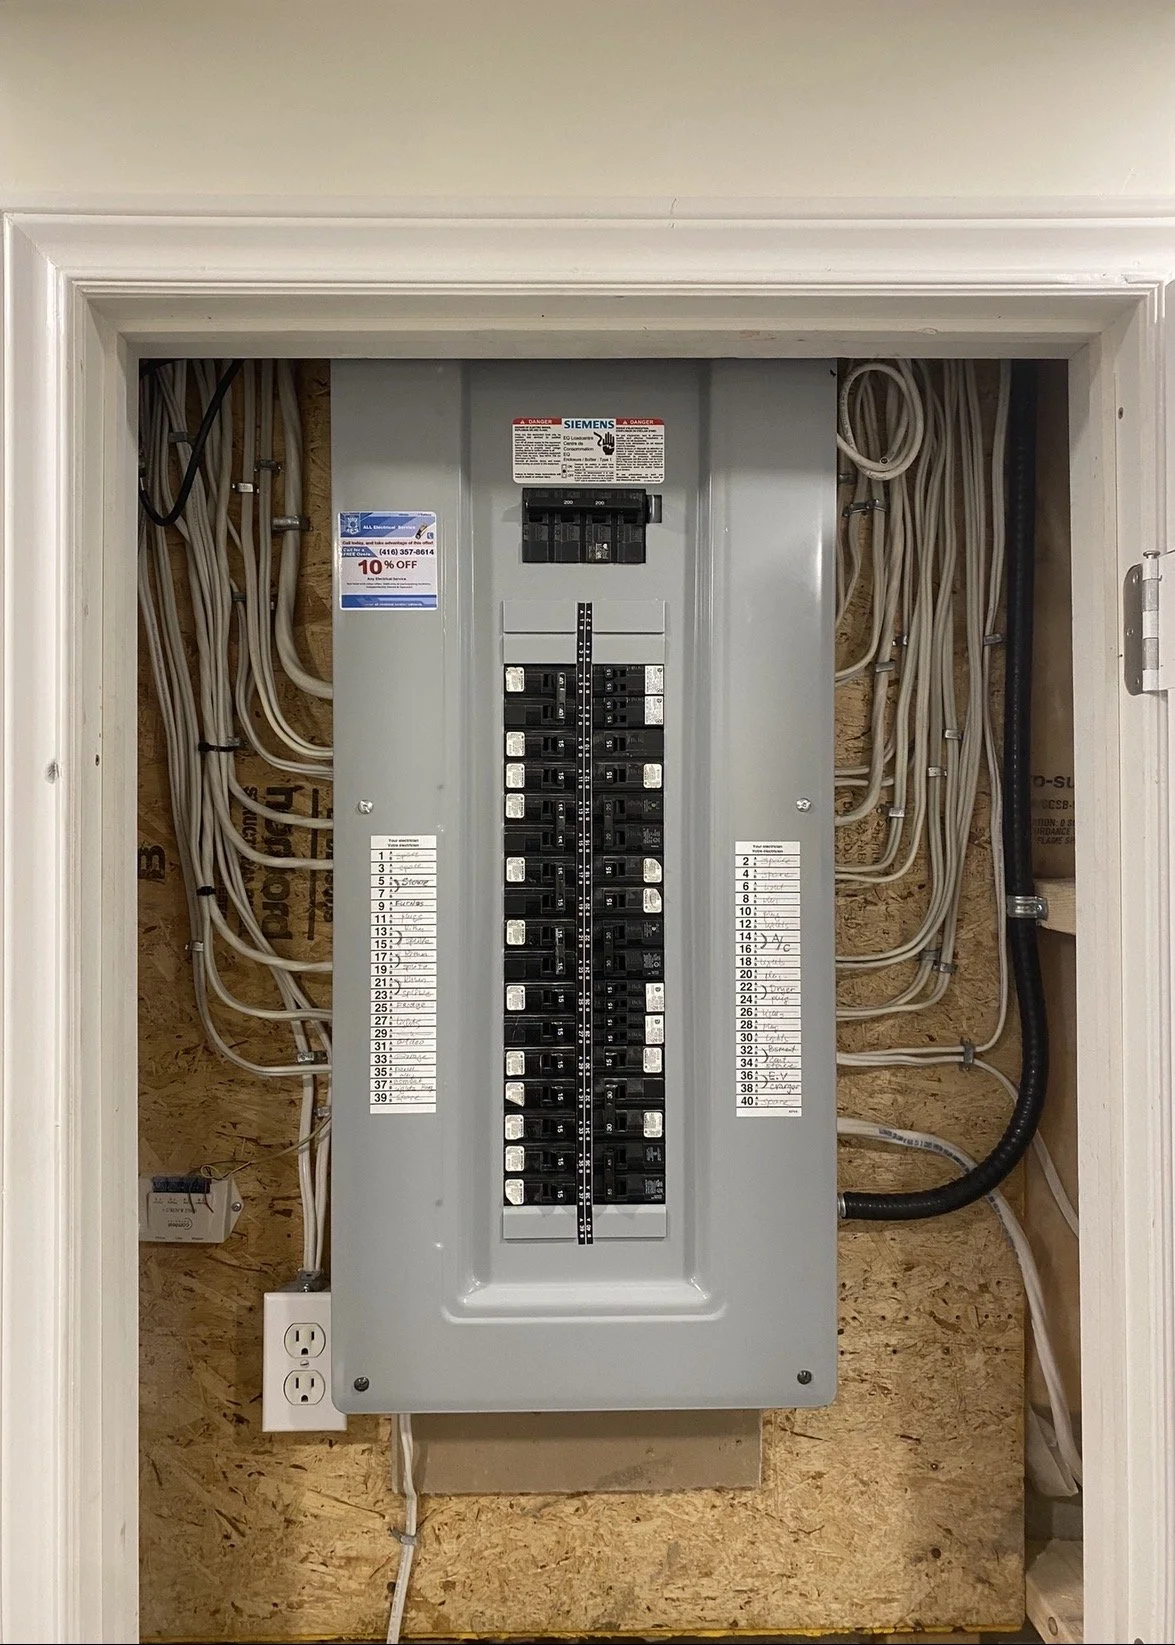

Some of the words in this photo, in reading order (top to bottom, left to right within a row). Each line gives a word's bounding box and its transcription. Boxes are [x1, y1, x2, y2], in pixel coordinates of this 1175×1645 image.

[564, 420, 614, 429] SIEMENS
[358, 559, 382, 575] 10
[384, 560, 394, 569] %
[396, 560, 418, 569] OFF
[607, 683, 611, 691] 15
[606, 740, 612, 748] 15
[559, 772, 564, 780] 15
[379, 852, 384, 860] 1
[743, 857, 749, 866] 2
[379, 864, 385, 873] 3
[606, 866, 612, 874] 15
[743, 869, 749, 878] 4
[379, 876, 385, 886] 5
[743, 882, 749, 891] 6
[379, 889, 385, 898] 7
[606, 898, 612, 906] 15
[743, 894, 749, 903] 8
[379, 901, 385, 910] 9
[740, 907, 752, 916] 10
[375, 914, 386, 923] 11
[740, 919, 752, 928] 12
[375, 927, 387, 936] 13
[740, 932, 752, 941] 14
[375, 940, 387, 949] 15
[740, 944, 752, 953] 16
[375, 953, 387, 962] 17
[740, 957, 752, 966] 18
[375, 965, 387, 974] 19
[558, 962, 563, 970] 15
[740, 970, 753, 979] 20
[374, 978, 387, 987] 21
[740, 982, 753, 991] 22
[374, 991, 387, 1000] 23
[740, 995, 753, 1004] 24
[374, 1003, 387, 1012] 25
[740, 1008, 753, 1016] 26
[374, 1016, 387, 1025] 27
[740, 1020, 753, 1029] 28
[374, 1029, 387, 1038] 29
[740, 1033, 753, 1042] 30
[374, 1042, 387, 1051] 31
[740, 1046, 753, 1054] 32
[374, 1055, 387, 1064] 33
[740, 1058, 753, 1067] 34
[374, 1067, 387, 1076] 35
[741, 1071, 753, 1080] 36
[374, 1080, 387, 1089] 37
[741, 1084, 753, 1093] 38
[374, 1093, 387, 1102] 39
[607, 1091, 613, 1099] 30
[741, 1096, 753, 1105] 40
[606, 1124, 612, 1132] 30
[558, 1158, 564, 1166] 15
[558, 1190, 563, 1198] 15
